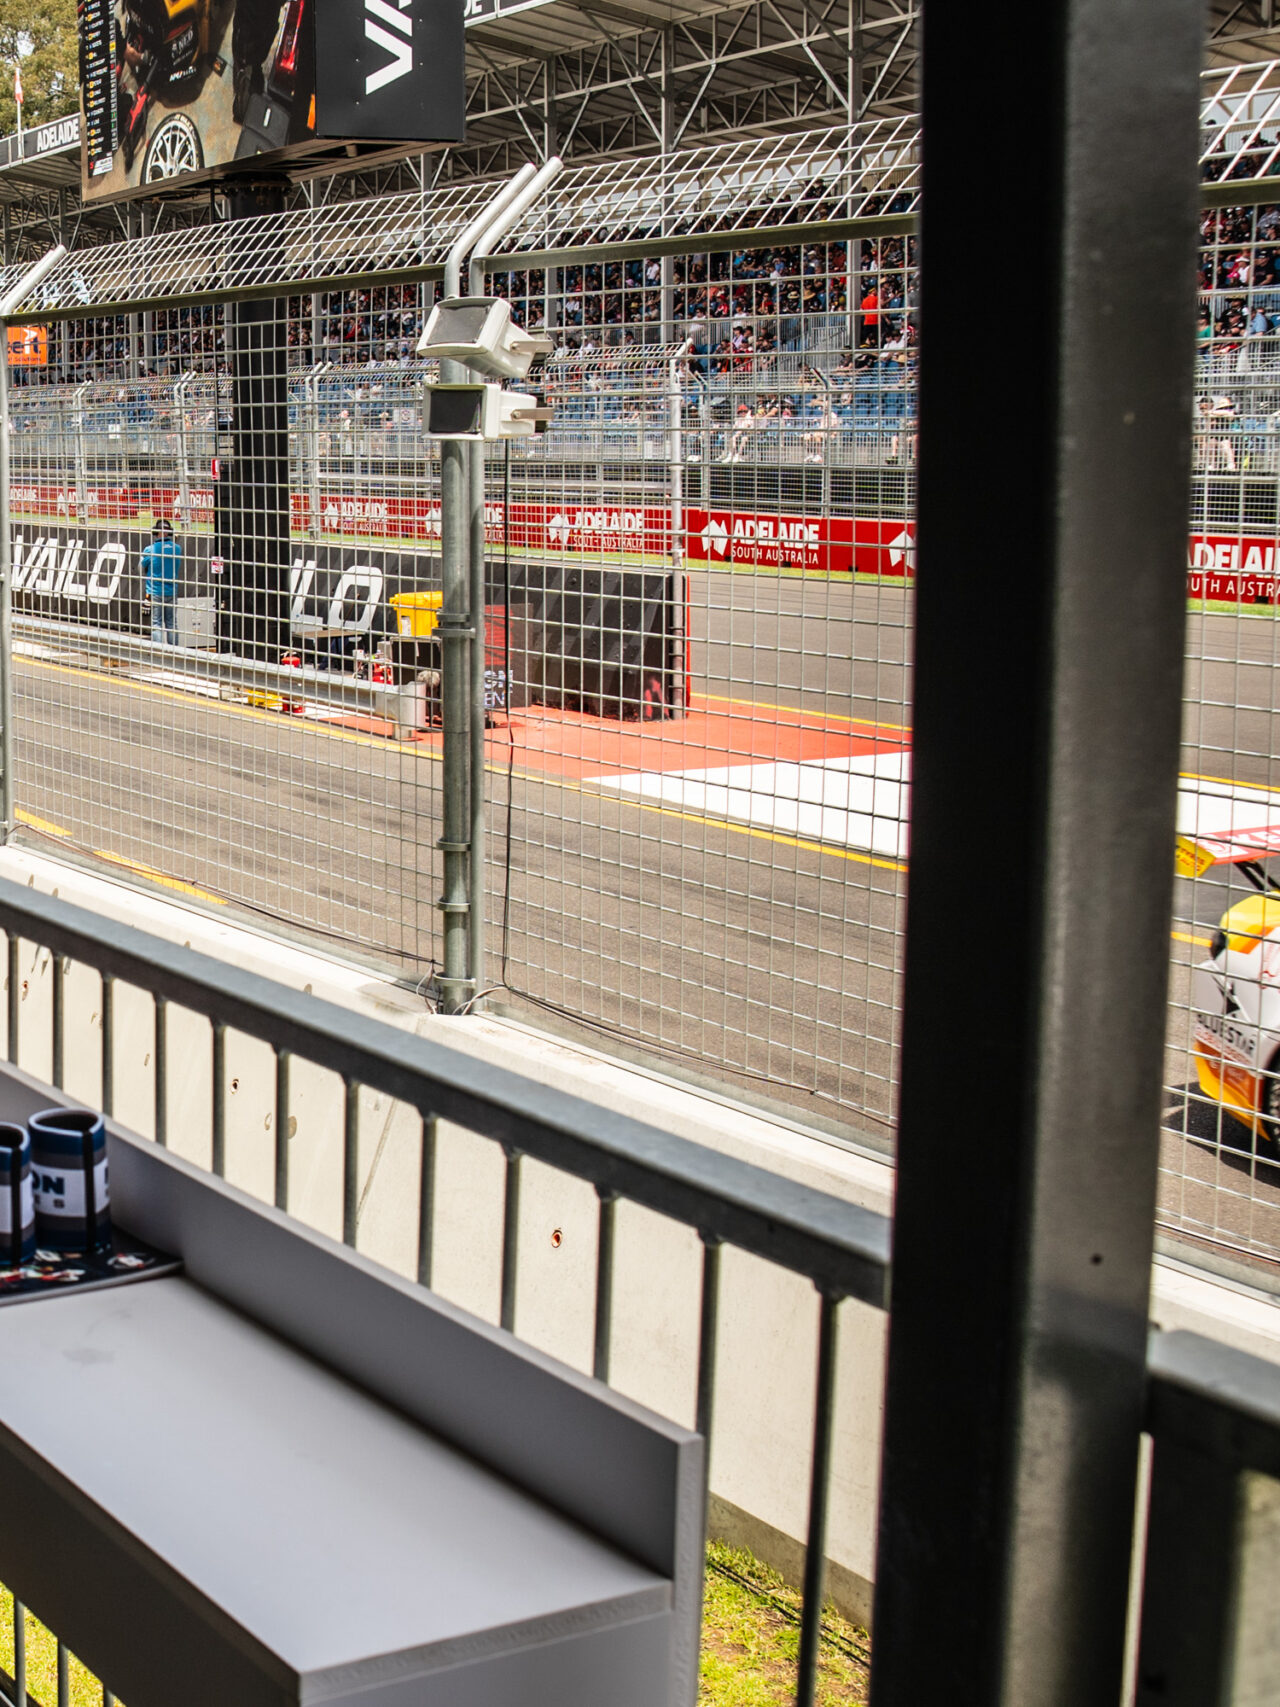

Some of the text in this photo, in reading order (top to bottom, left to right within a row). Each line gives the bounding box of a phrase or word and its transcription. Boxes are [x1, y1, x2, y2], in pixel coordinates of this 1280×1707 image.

[37, 118, 80, 152] ADELAIDE
[574, 511, 643, 535] ADELAIDE
[733, 519, 820, 550] ADELAIDE
[11, 535, 127, 605] VAILO
[733, 546, 819, 565] SOUTH AUSTRALIA
